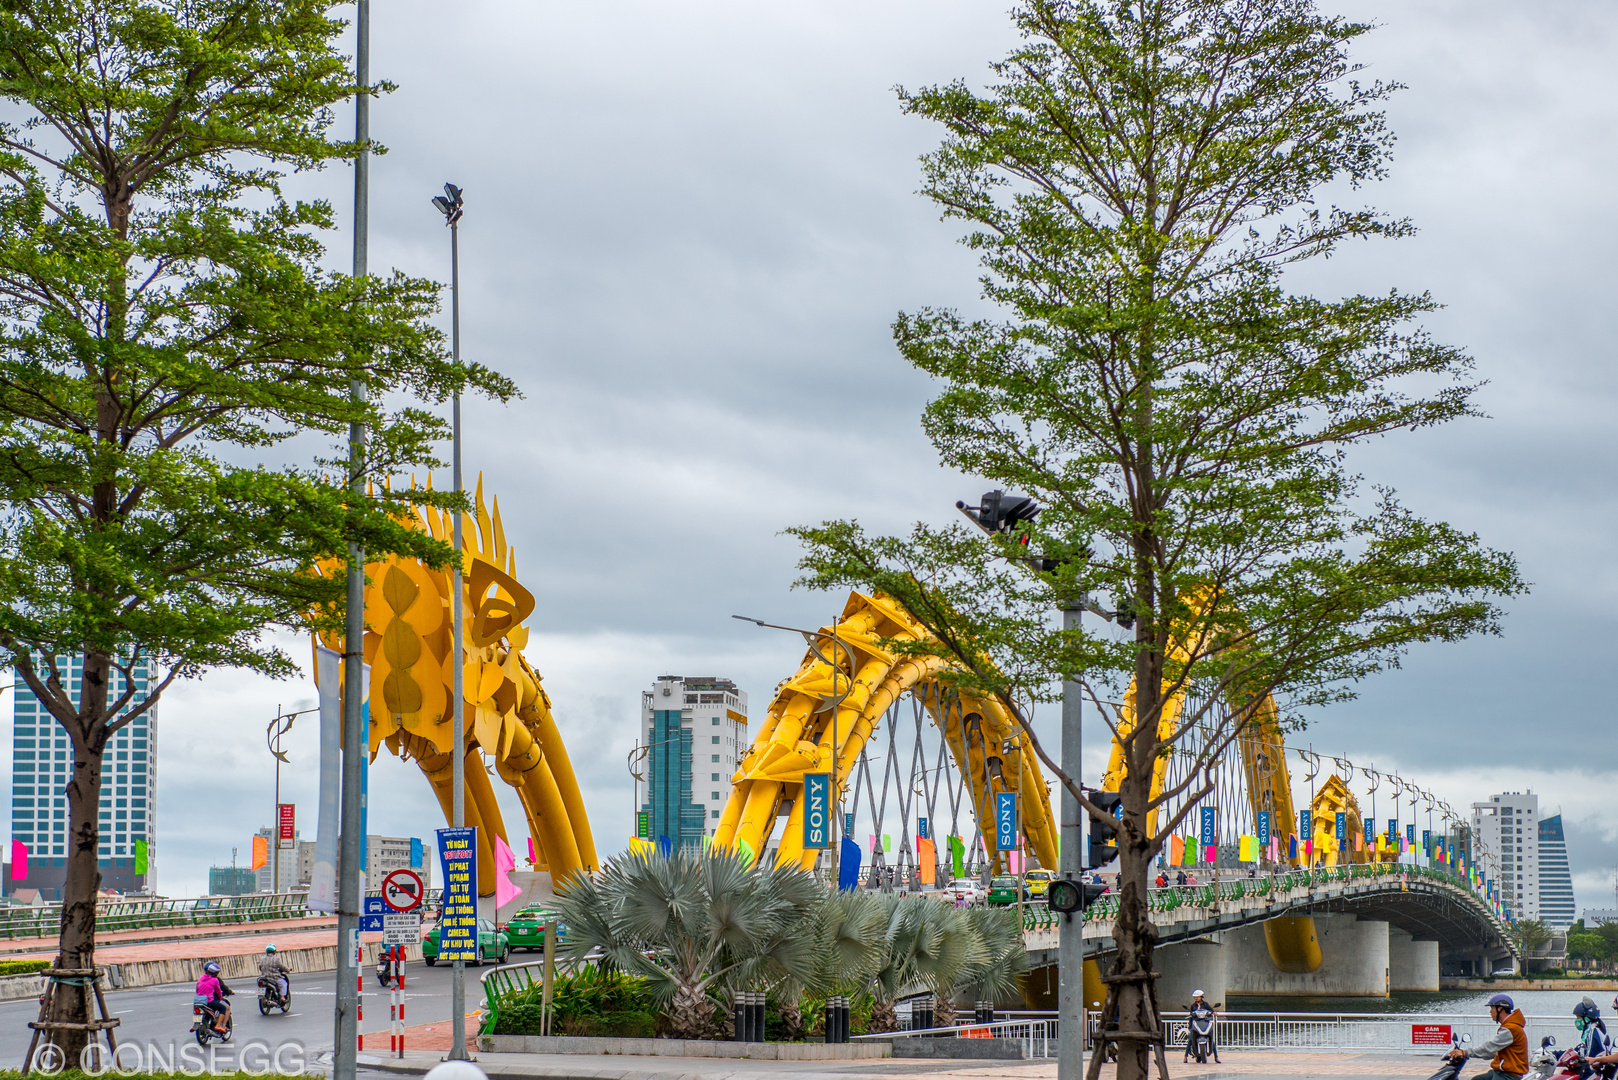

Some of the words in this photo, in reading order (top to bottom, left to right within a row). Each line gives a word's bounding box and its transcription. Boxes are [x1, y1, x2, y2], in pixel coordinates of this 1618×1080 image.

[810, 778, 822, 843] SONY
[1002, 796, 1011, 846] SONY
[454, 839, 468, 848] NGÀY
[455, 894, 470, 903] TOÀN
[456, 905, 474, 914] THÔNG
[459, 915, 476, 925] THỐNG
[448, 929, 469, 937] CAMERA
[451, 940, 462, 948] KHU
[464, 939, 474, 949] VỰC
